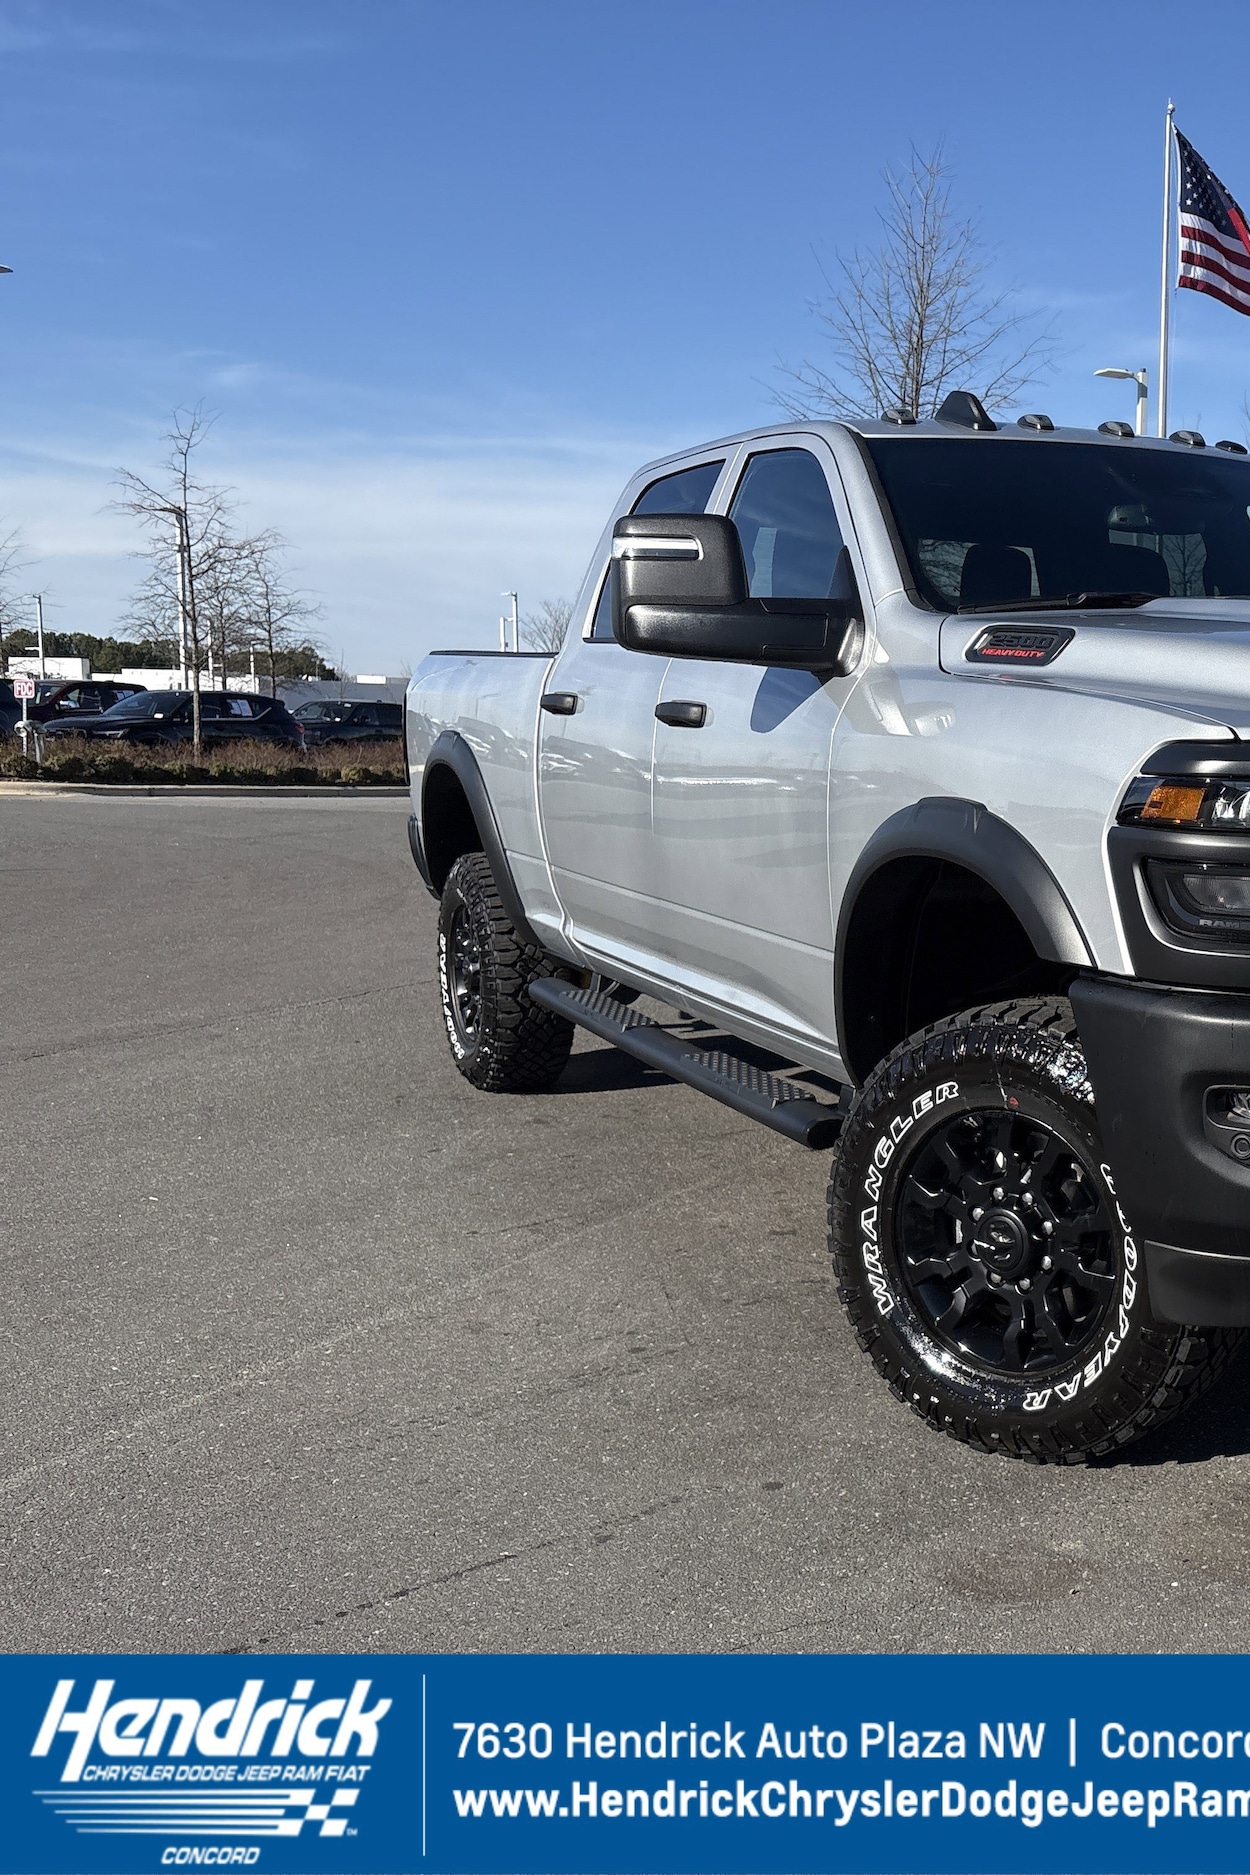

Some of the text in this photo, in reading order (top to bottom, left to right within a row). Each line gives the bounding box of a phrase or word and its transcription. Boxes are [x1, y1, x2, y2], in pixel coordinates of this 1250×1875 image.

[989, 634, 1055, 649] 2500
[982, 649, 1046, 658] HEAVY DUTY
[16, 683, 33, 696] FDC
[1199, 918, 1240, 929] RAM
[861, 1081, 960, 1316] WRANGLER
